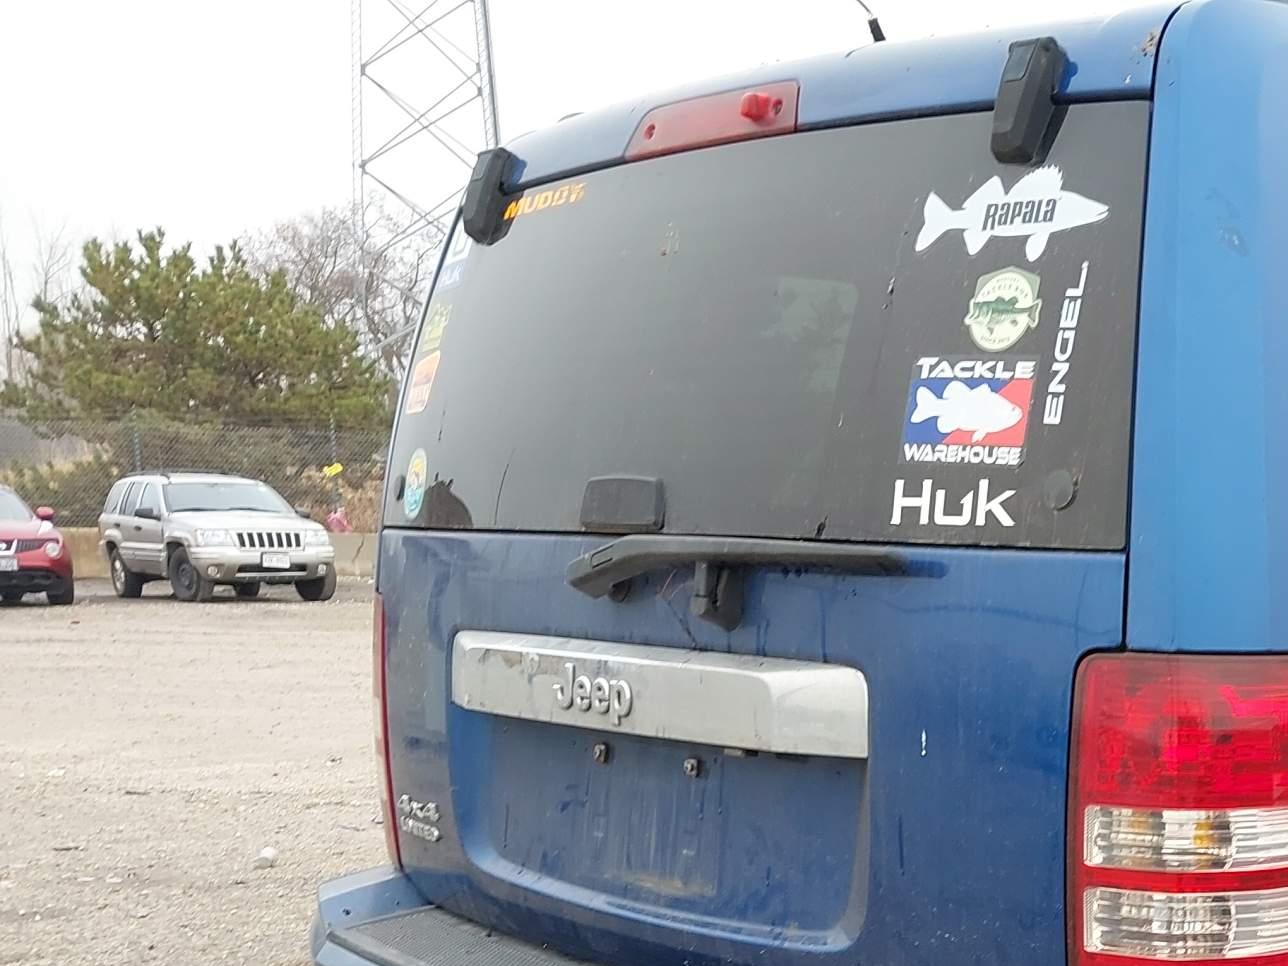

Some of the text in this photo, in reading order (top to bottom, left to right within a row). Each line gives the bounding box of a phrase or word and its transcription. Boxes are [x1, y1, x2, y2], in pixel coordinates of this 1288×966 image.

[1042, 260, 1090, 425] ENGEL
[915, 356, 1037, 380] TACKLE
[903, 443, 1024, 466] WAREHOUSE
[552, 661, 633, 727] Jeep
